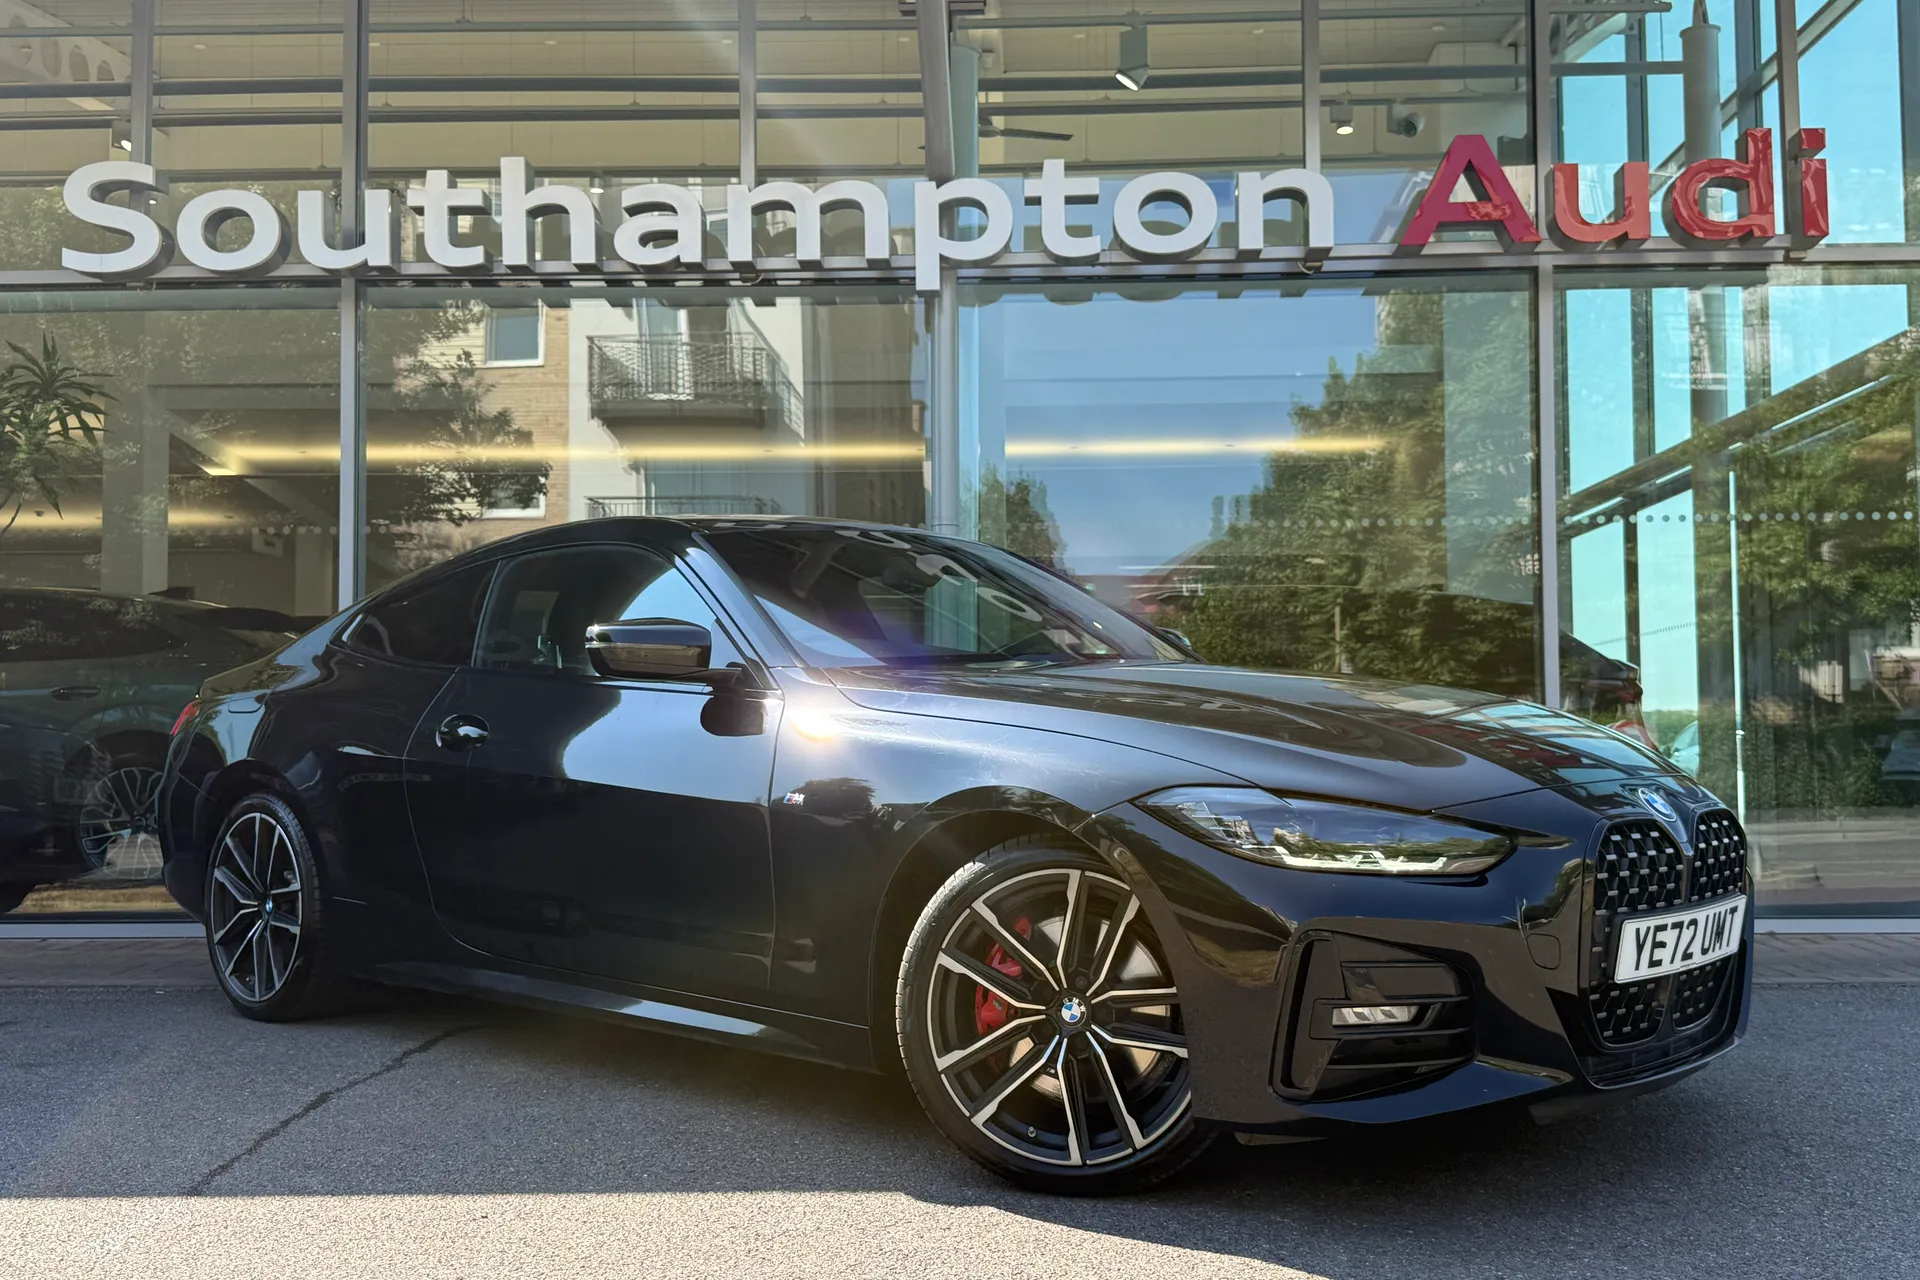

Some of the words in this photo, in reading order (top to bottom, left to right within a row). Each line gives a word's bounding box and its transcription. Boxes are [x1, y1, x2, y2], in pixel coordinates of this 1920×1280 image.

[61, 157, 1335, 291] Southampton
[1400, 127, 1829, 246] Audi
[1633, 917, 1699, 971] YE72
[1700, 905, 1739, 956] UMT
